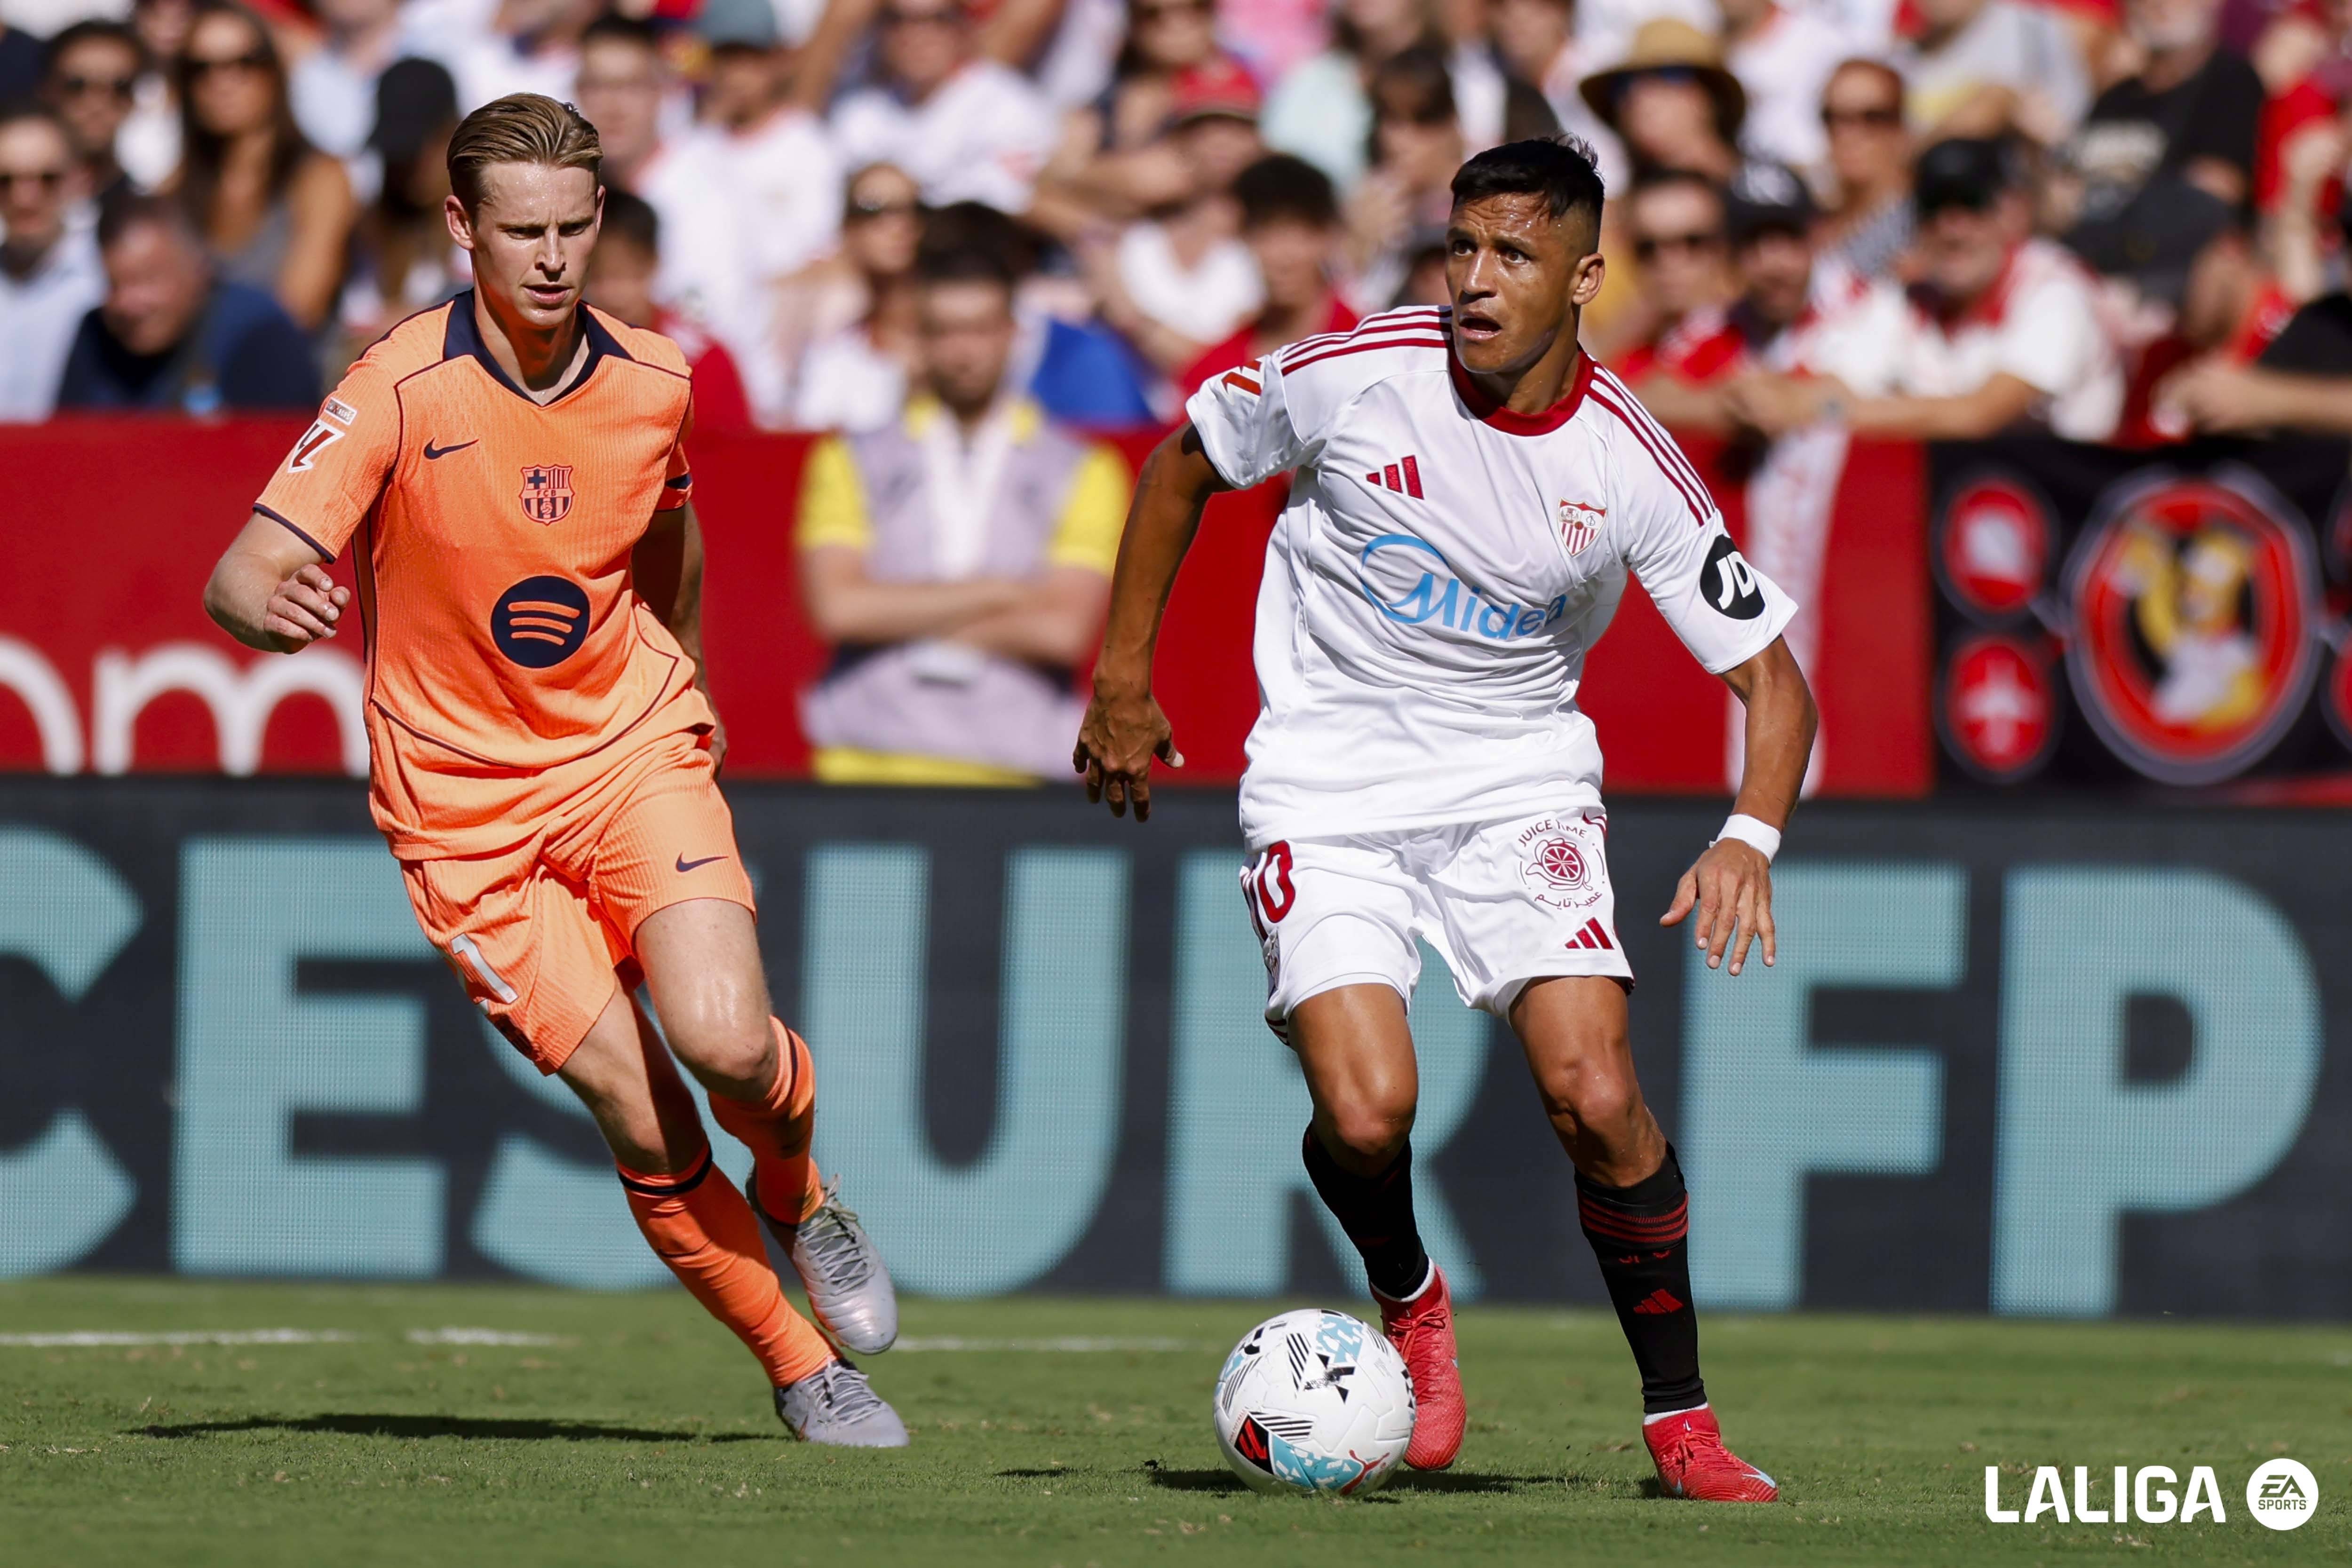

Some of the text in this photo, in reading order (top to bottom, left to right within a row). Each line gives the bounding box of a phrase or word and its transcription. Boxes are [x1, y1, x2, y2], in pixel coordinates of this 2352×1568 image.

[1362, 561, 1567, 640] Midea
[1716, 551, 1756, 610] JD
[1518, 819, 1552, 847] JUICE
[1677, 857, 2327, 1317] FP
